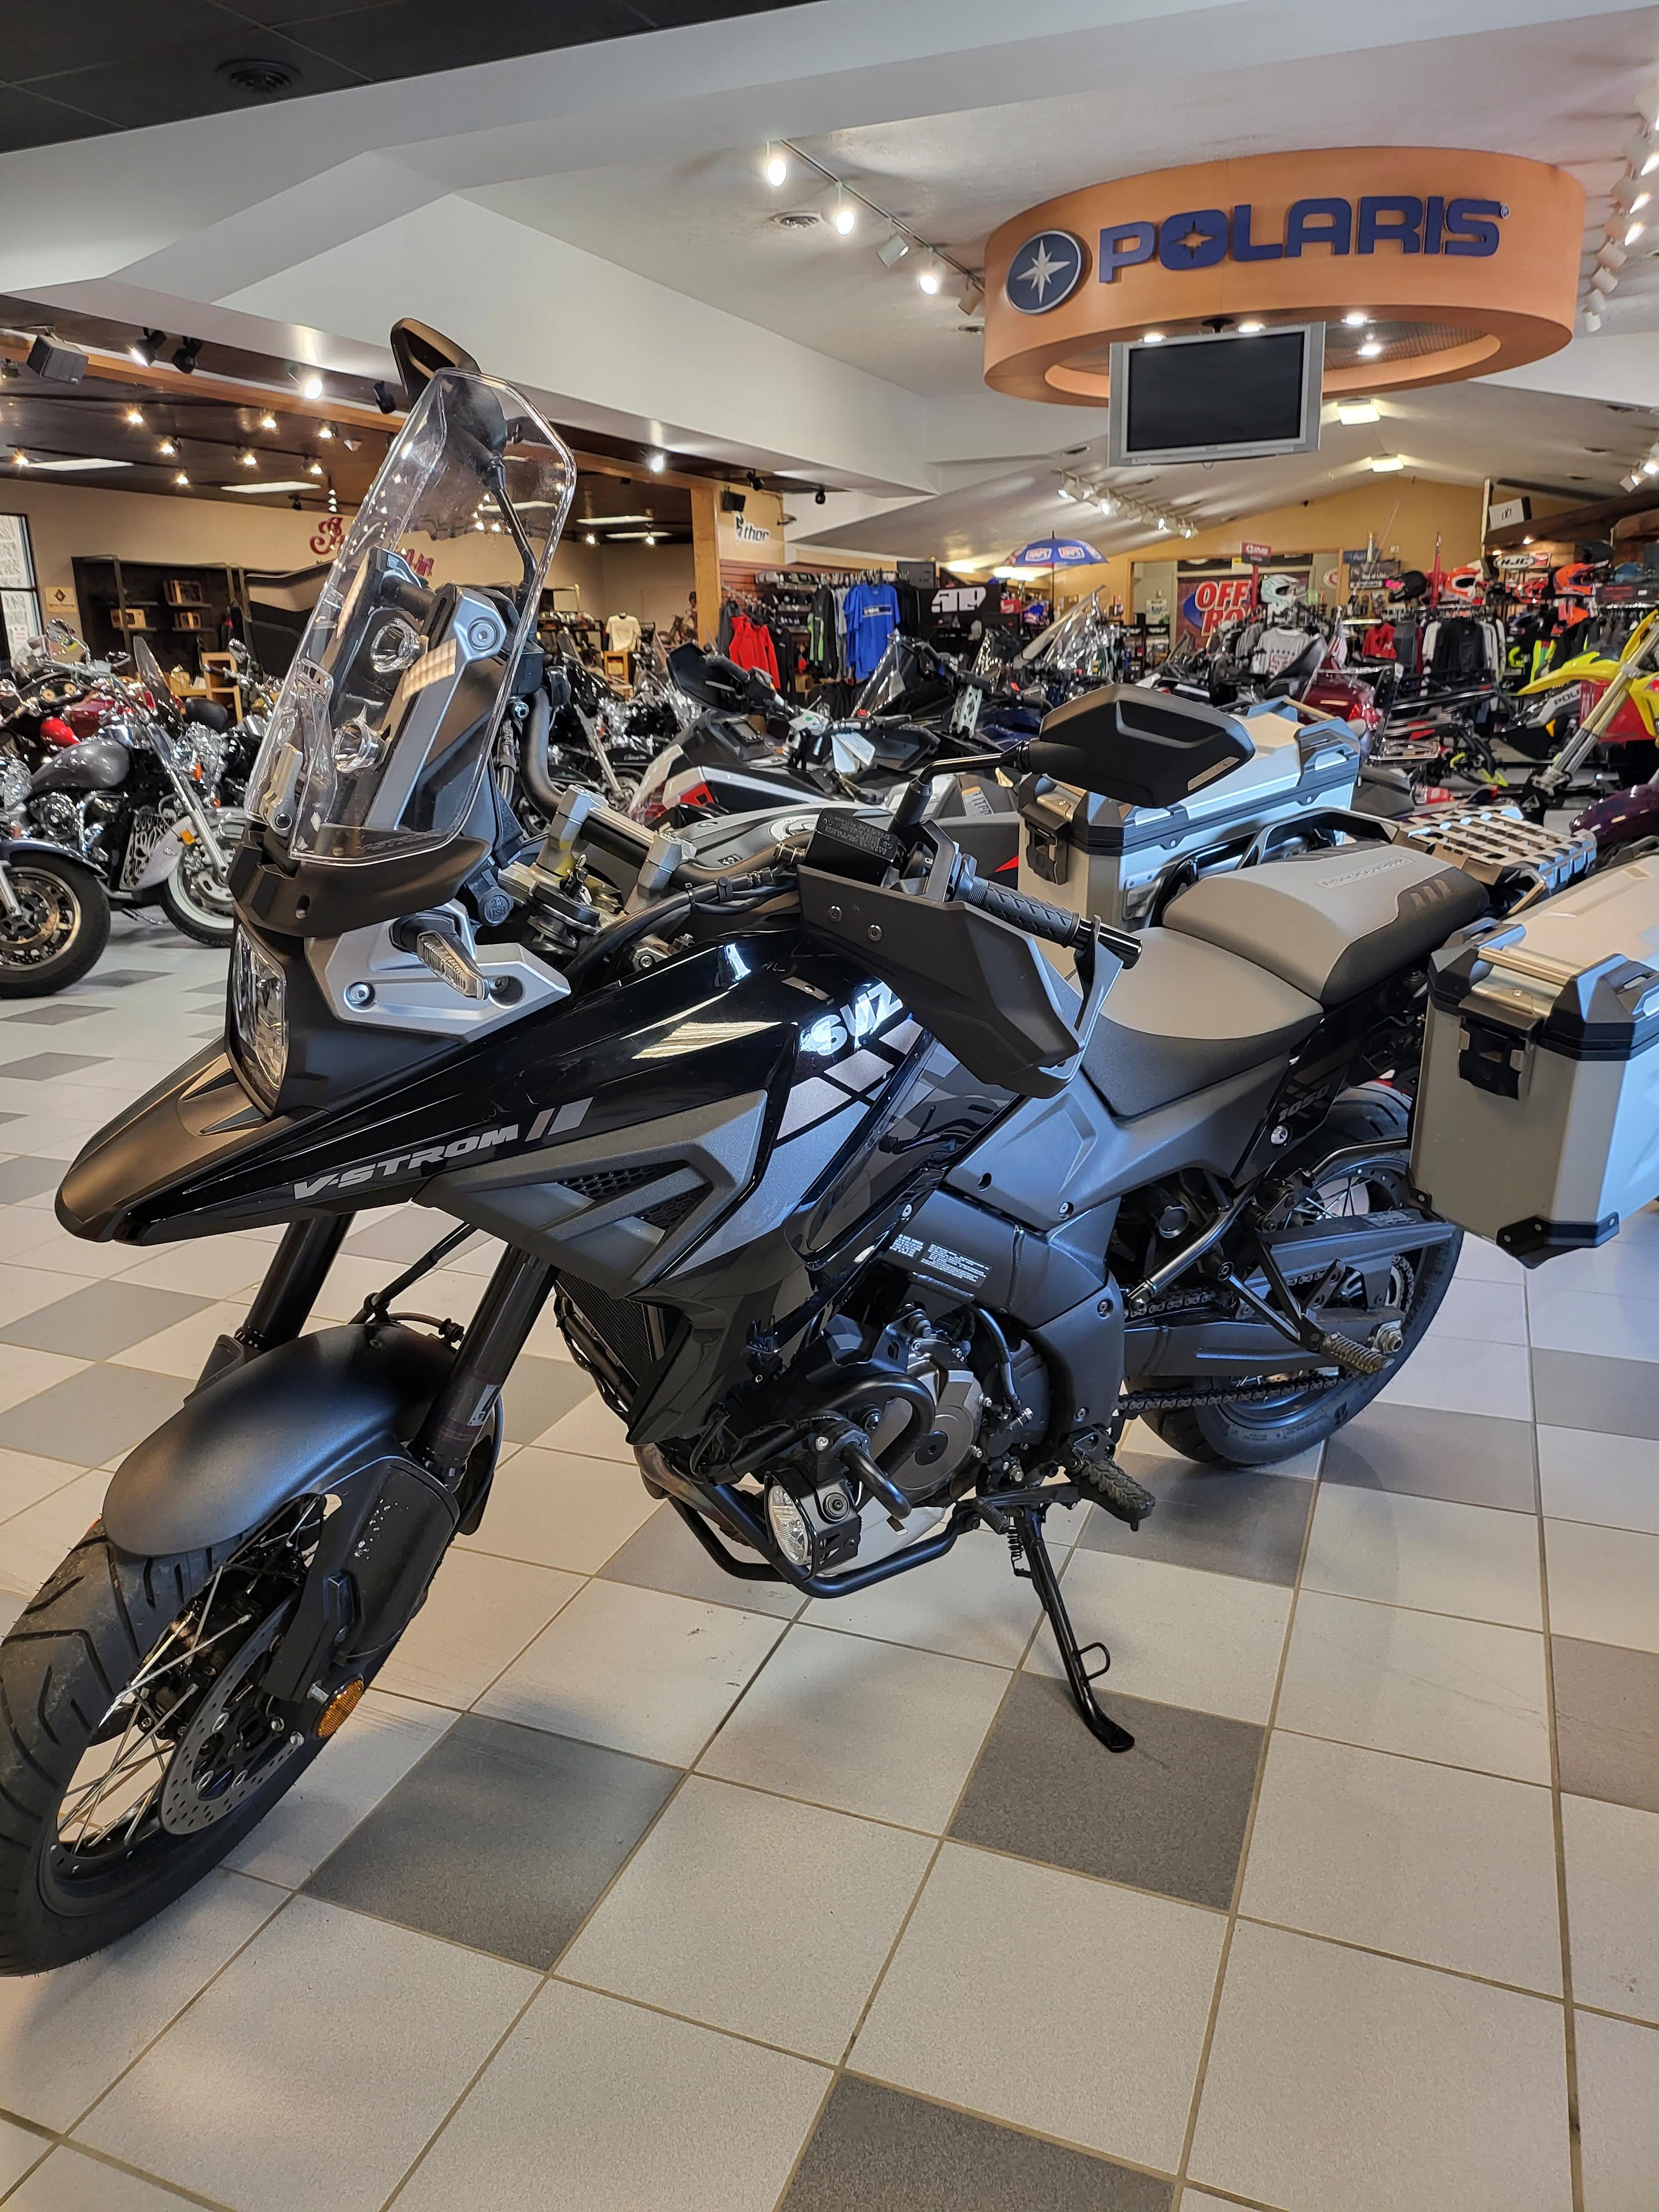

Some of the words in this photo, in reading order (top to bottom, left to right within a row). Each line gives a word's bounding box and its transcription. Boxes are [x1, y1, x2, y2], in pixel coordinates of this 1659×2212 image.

[1099, 196, 1501, 283] POLARIS
[744, 525, 769, 541] thor
[1195, 579, 1251, 611] OFF
[1201, 607, 1251, 636] RO
[489, 906, 506, 919] USB
[491, 897, 503, 909] 2A
[1278, 1083, 1331, 1123] 1050
[293, 1124, 519, 1199] V-STROM
